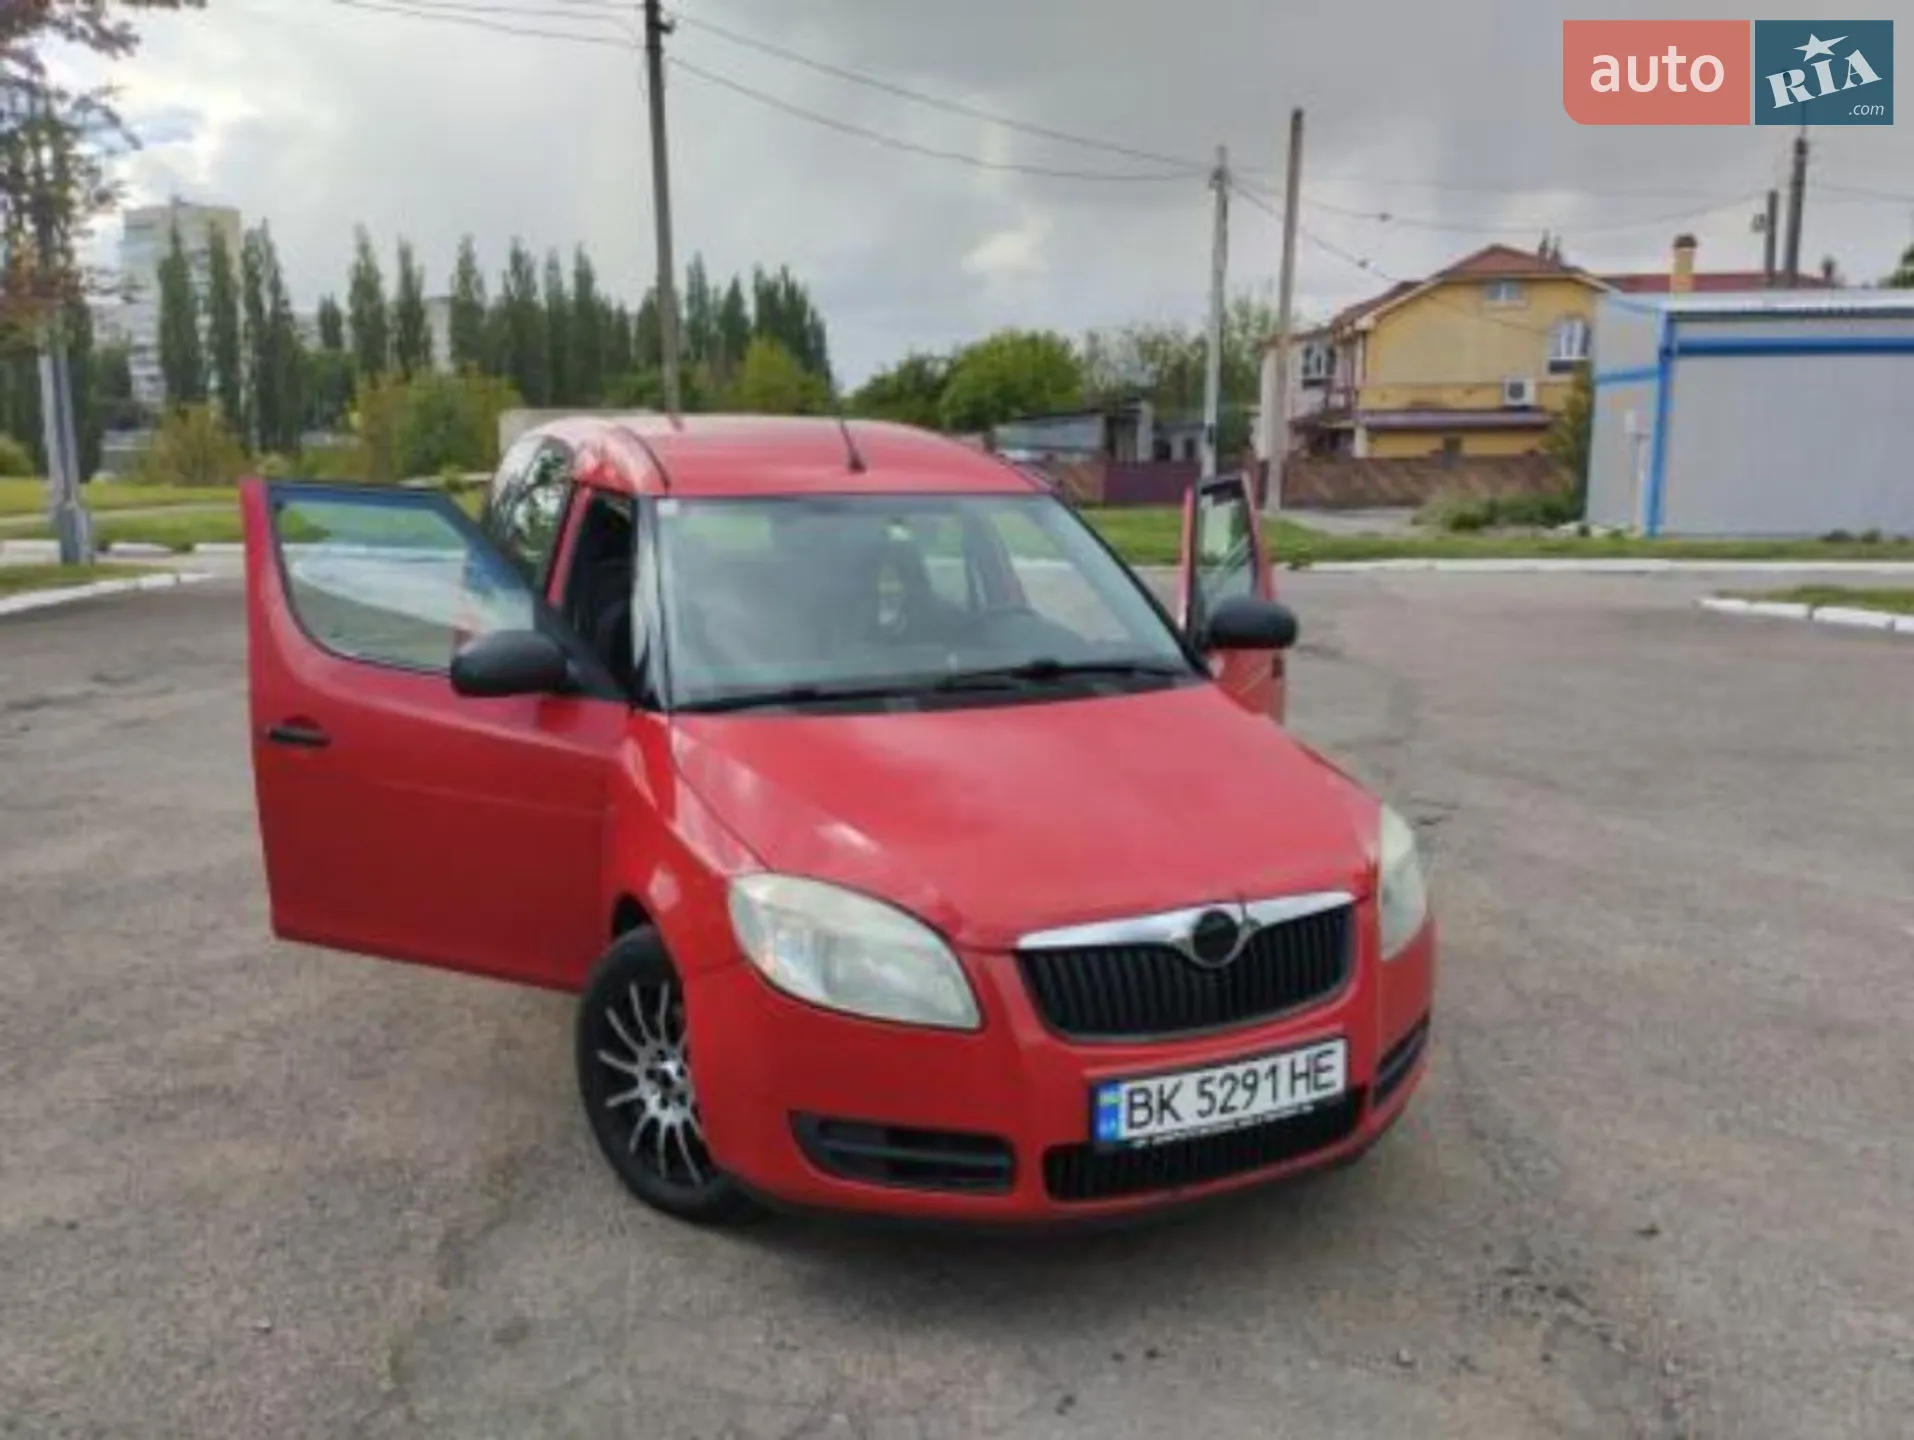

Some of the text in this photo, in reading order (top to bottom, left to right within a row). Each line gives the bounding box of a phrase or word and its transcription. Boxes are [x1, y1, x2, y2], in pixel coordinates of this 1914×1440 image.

[1126, 1079, 1184, 1130] BK
[1196, 1064, 1278, 1118] 5291
[1289, 1049, 1337, 1097] HE
